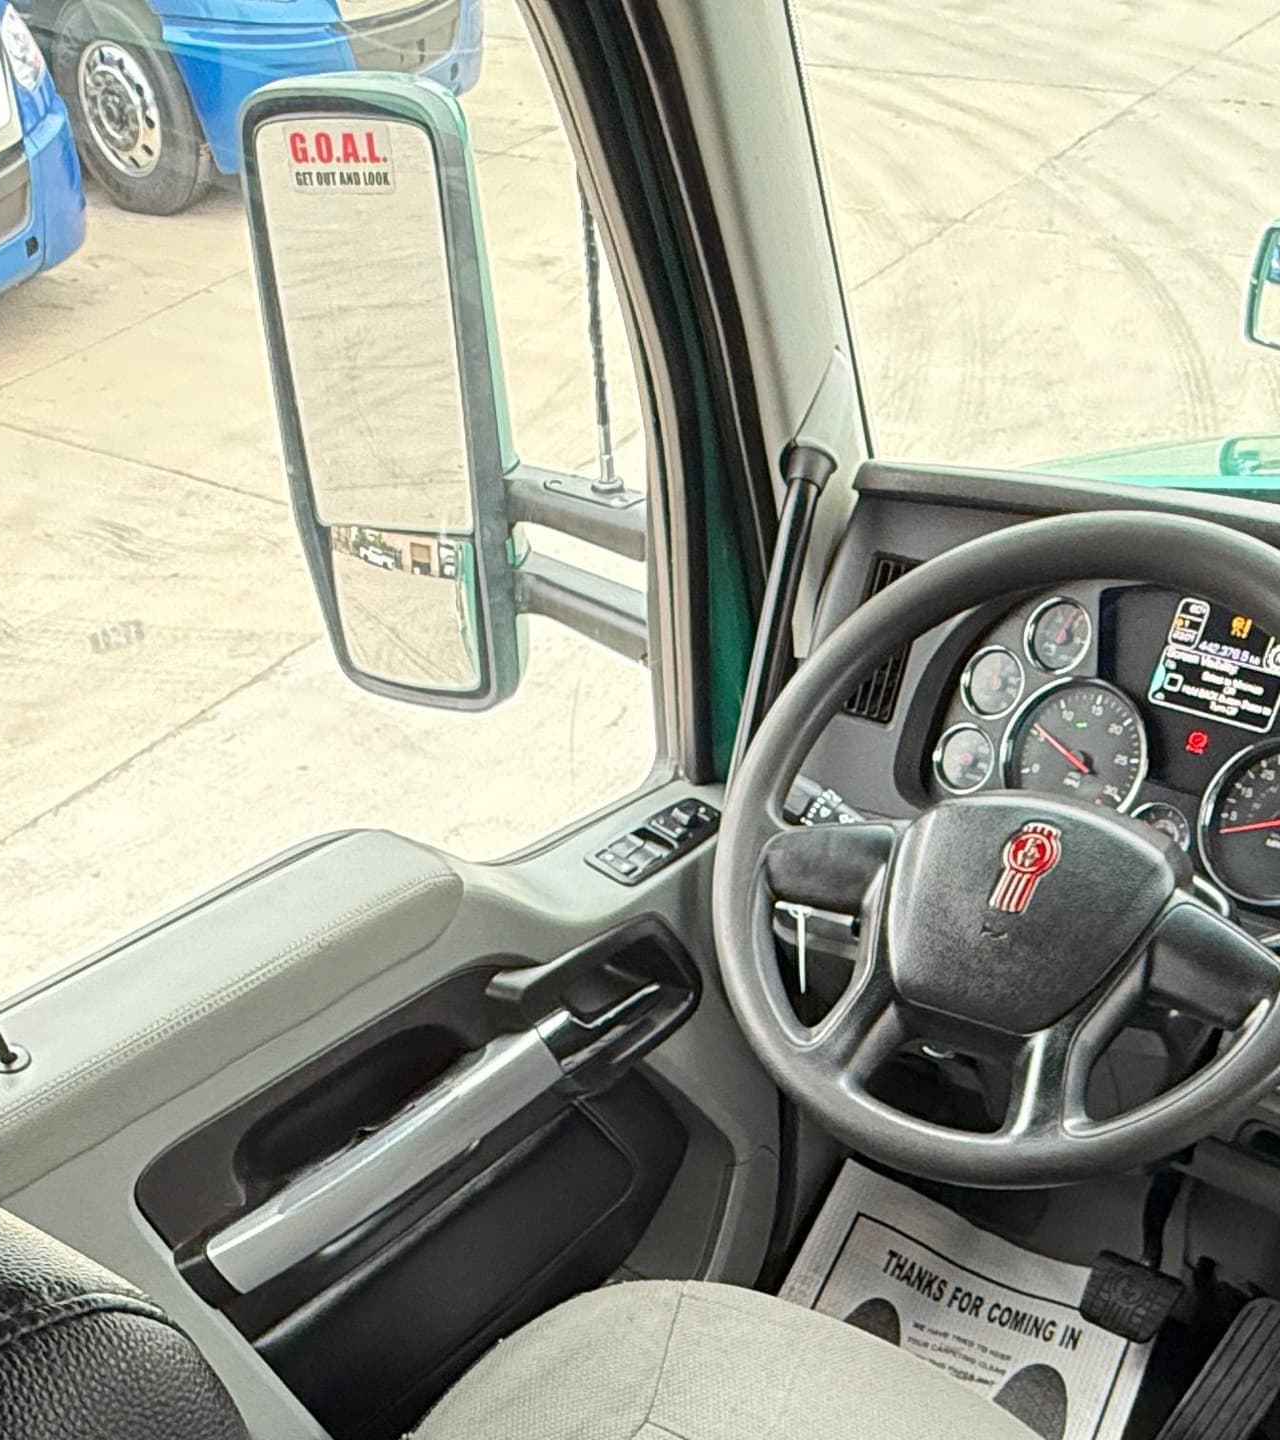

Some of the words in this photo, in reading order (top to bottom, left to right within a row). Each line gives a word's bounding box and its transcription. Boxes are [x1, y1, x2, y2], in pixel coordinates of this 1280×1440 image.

[290, 132, 388, 164] G.O.A.L.
[295, 171, 314, 186] GET
[316, 171, 336, 186] OUT
[340, 171, 361, 186] AND
[363, 171, 390, 186] LOOK
[1091, 705, 1104, 716] 15
[1108, 724, 1123, 735] 20
[1114, 754, 1128, 765] 25
[1260, 769, 1275, 781] 25
[1241, 786, 1253, 798] 15
[882, 1249, 948, 1303] THANKS
[947, 1286, 985, 1318] FOR
[986, 1302, 1057, 1343] COMING
[1058, 1324, 1083, 1351] IN
